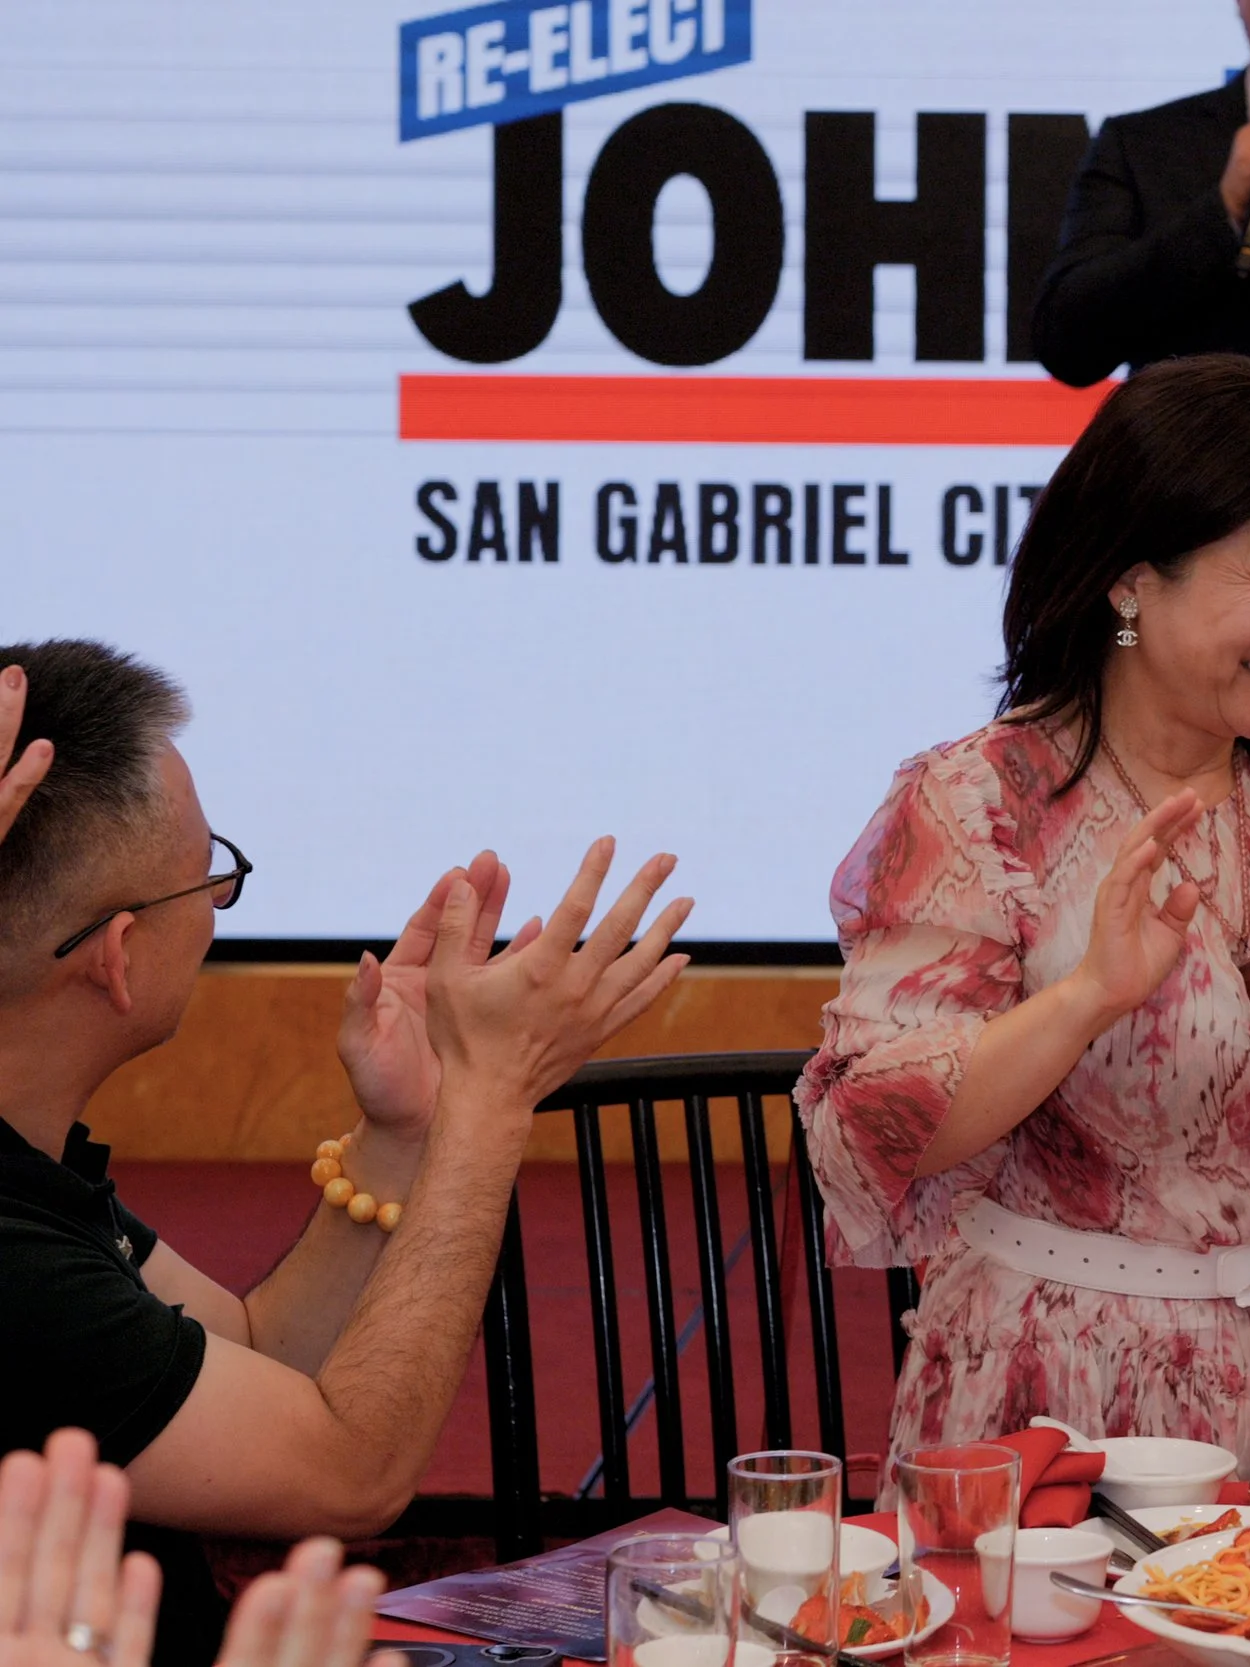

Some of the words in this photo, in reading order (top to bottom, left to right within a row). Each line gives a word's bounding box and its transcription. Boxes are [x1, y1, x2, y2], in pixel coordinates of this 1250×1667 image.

[416, 0, 725, 120] RE-ELECT
[416, 481, 559, 562] SAN
[596, 483, 909, 565] GABRIEL
